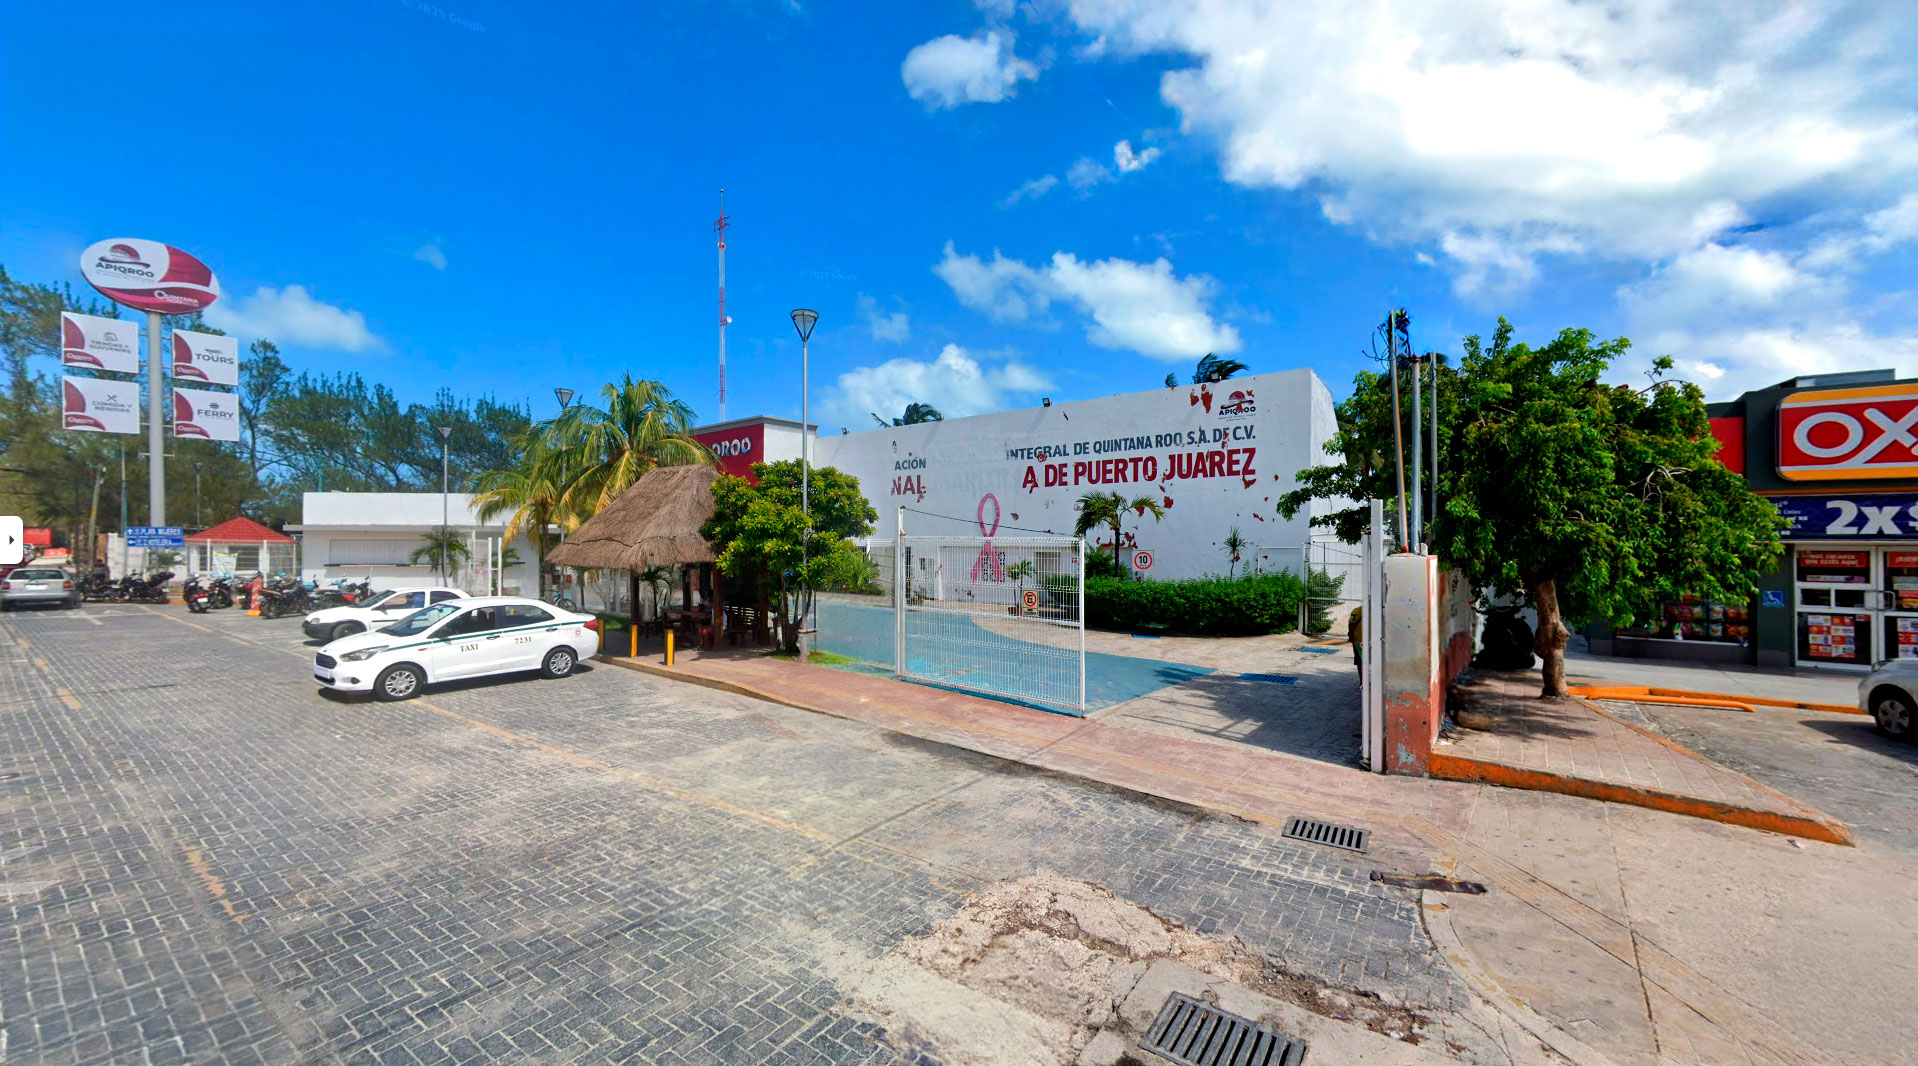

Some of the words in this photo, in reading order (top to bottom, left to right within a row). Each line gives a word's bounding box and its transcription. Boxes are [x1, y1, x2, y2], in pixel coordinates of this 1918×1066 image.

[96, 262, 154, 278] APIQROO
[195, 353, 234, 364] TOURS
[197, 409, 234, 418] FERRY
[1006, 444, 1069, 460] INTEGRAL
[1074, 442, 1090, 456] DE
[1093, 435, 1153, 454] QUINTANA
[1156, 432, 1182, 448] ROO
[1187, 430, 1210, 445] S.A.
[1233, 425, 1256, 441] C.V.
[1045, 463, 1068, 487] DE
[1074, 456, 1157, 485] PUERTO
[1164, 448, 1256, 481] JUAREZ
[1139, 555, 1148, 564] 10
[460, 643, 478, 652] TAXI
